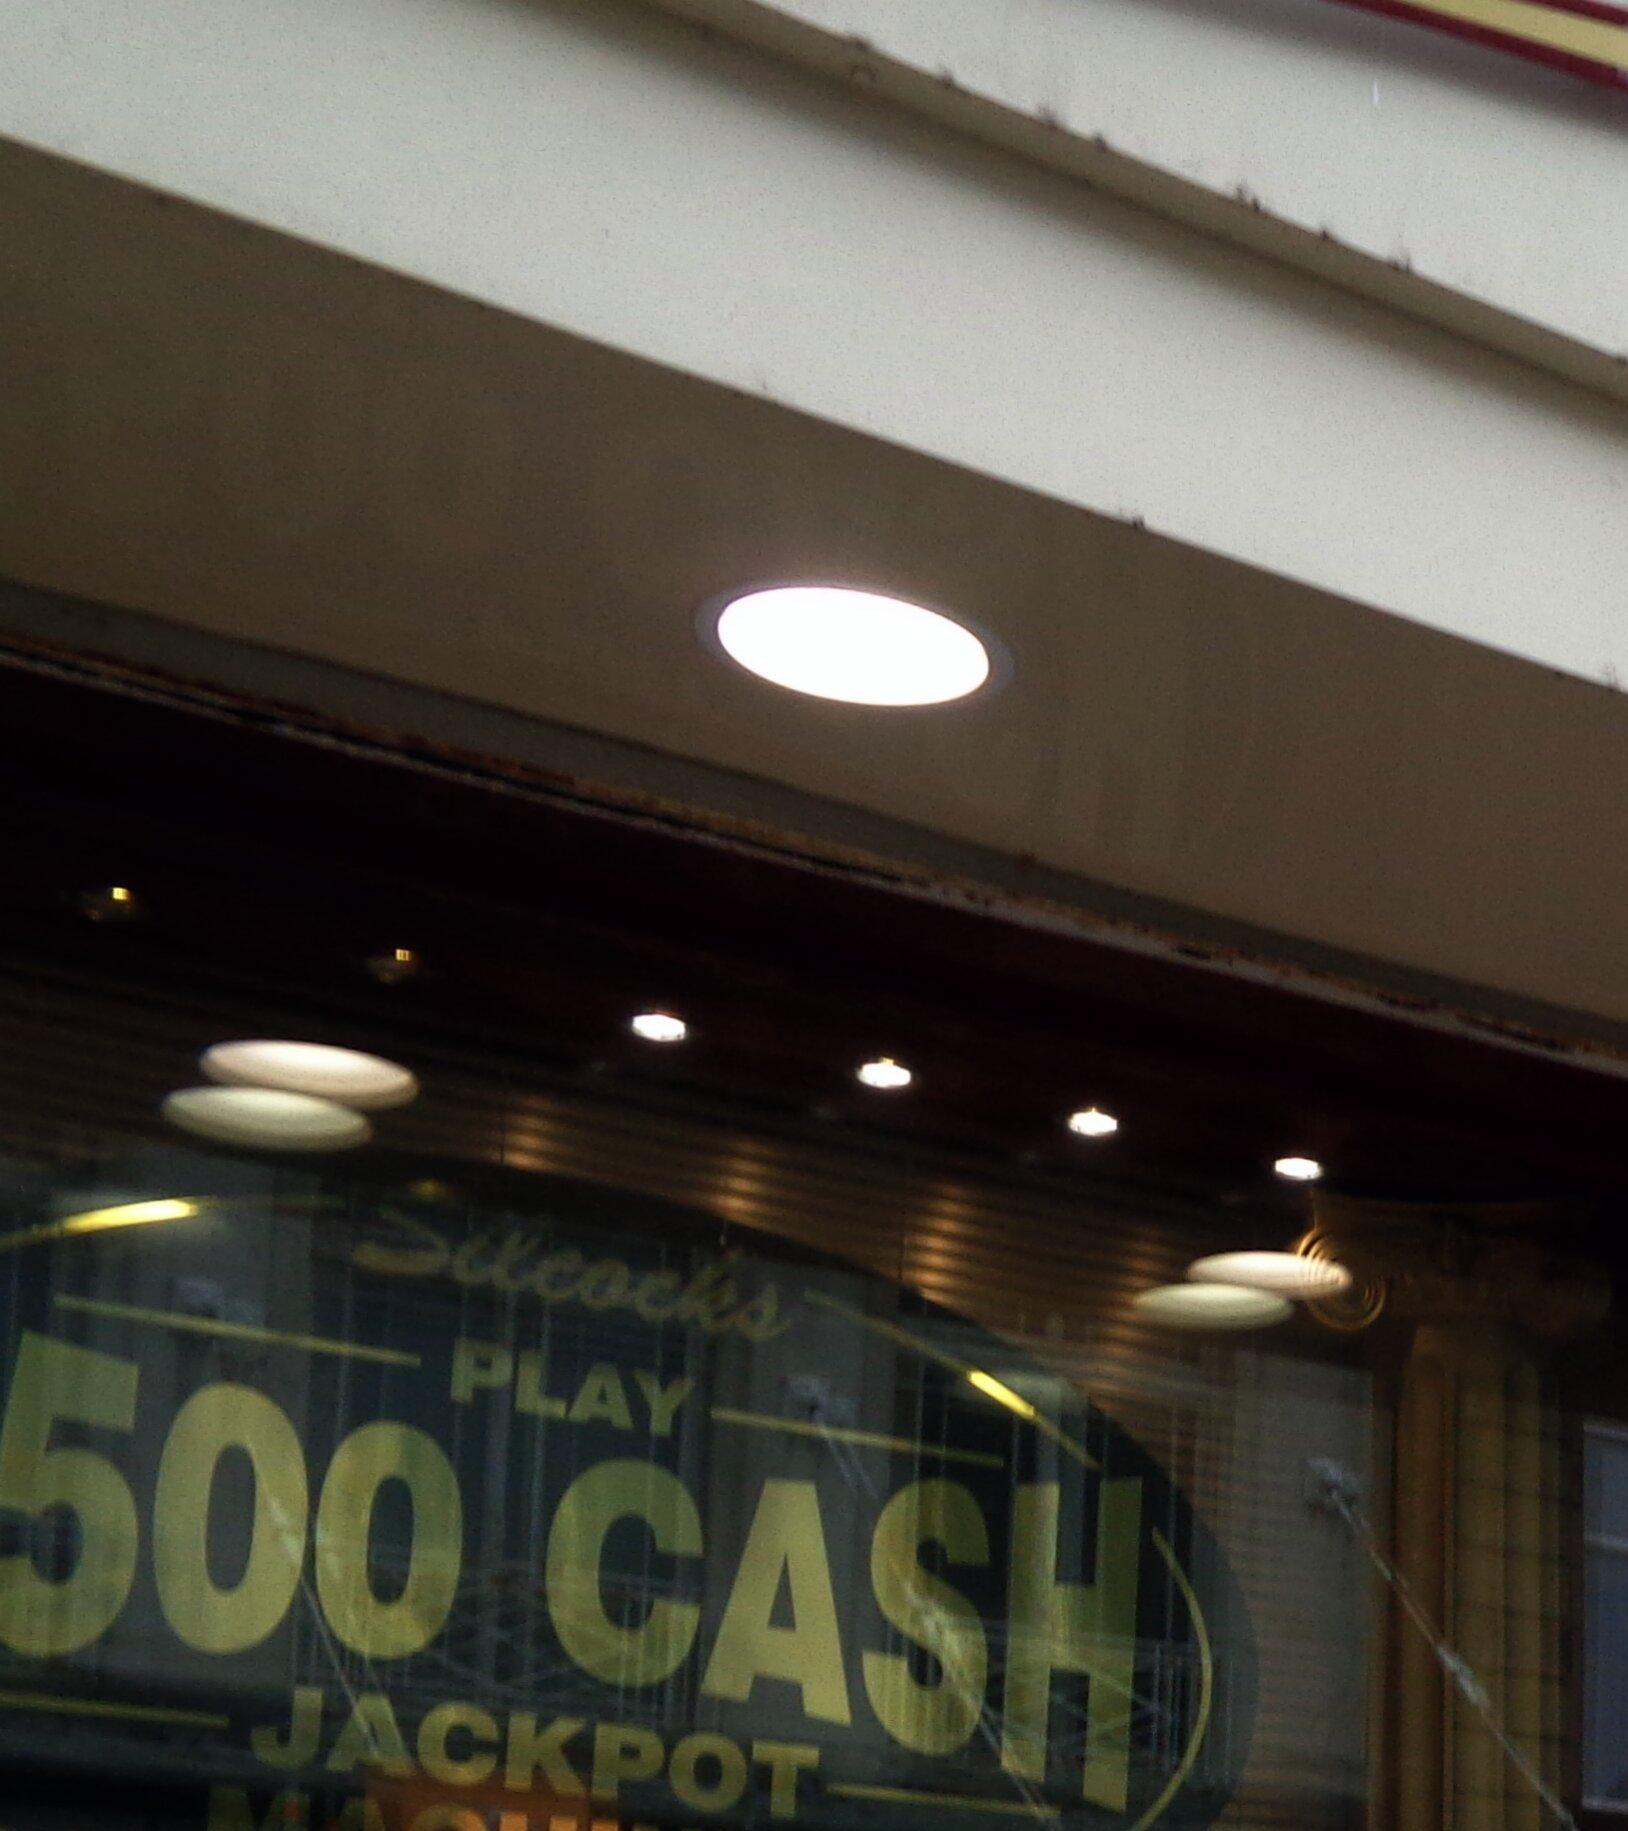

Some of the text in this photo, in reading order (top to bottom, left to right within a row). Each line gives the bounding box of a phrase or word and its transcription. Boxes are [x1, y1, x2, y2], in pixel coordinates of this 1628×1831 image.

[450, 1337, 696, 1437] PLAY
[545, 1457, 1144, 1811] CASH
[250, 1688, 819, 1818] JACKPOT
